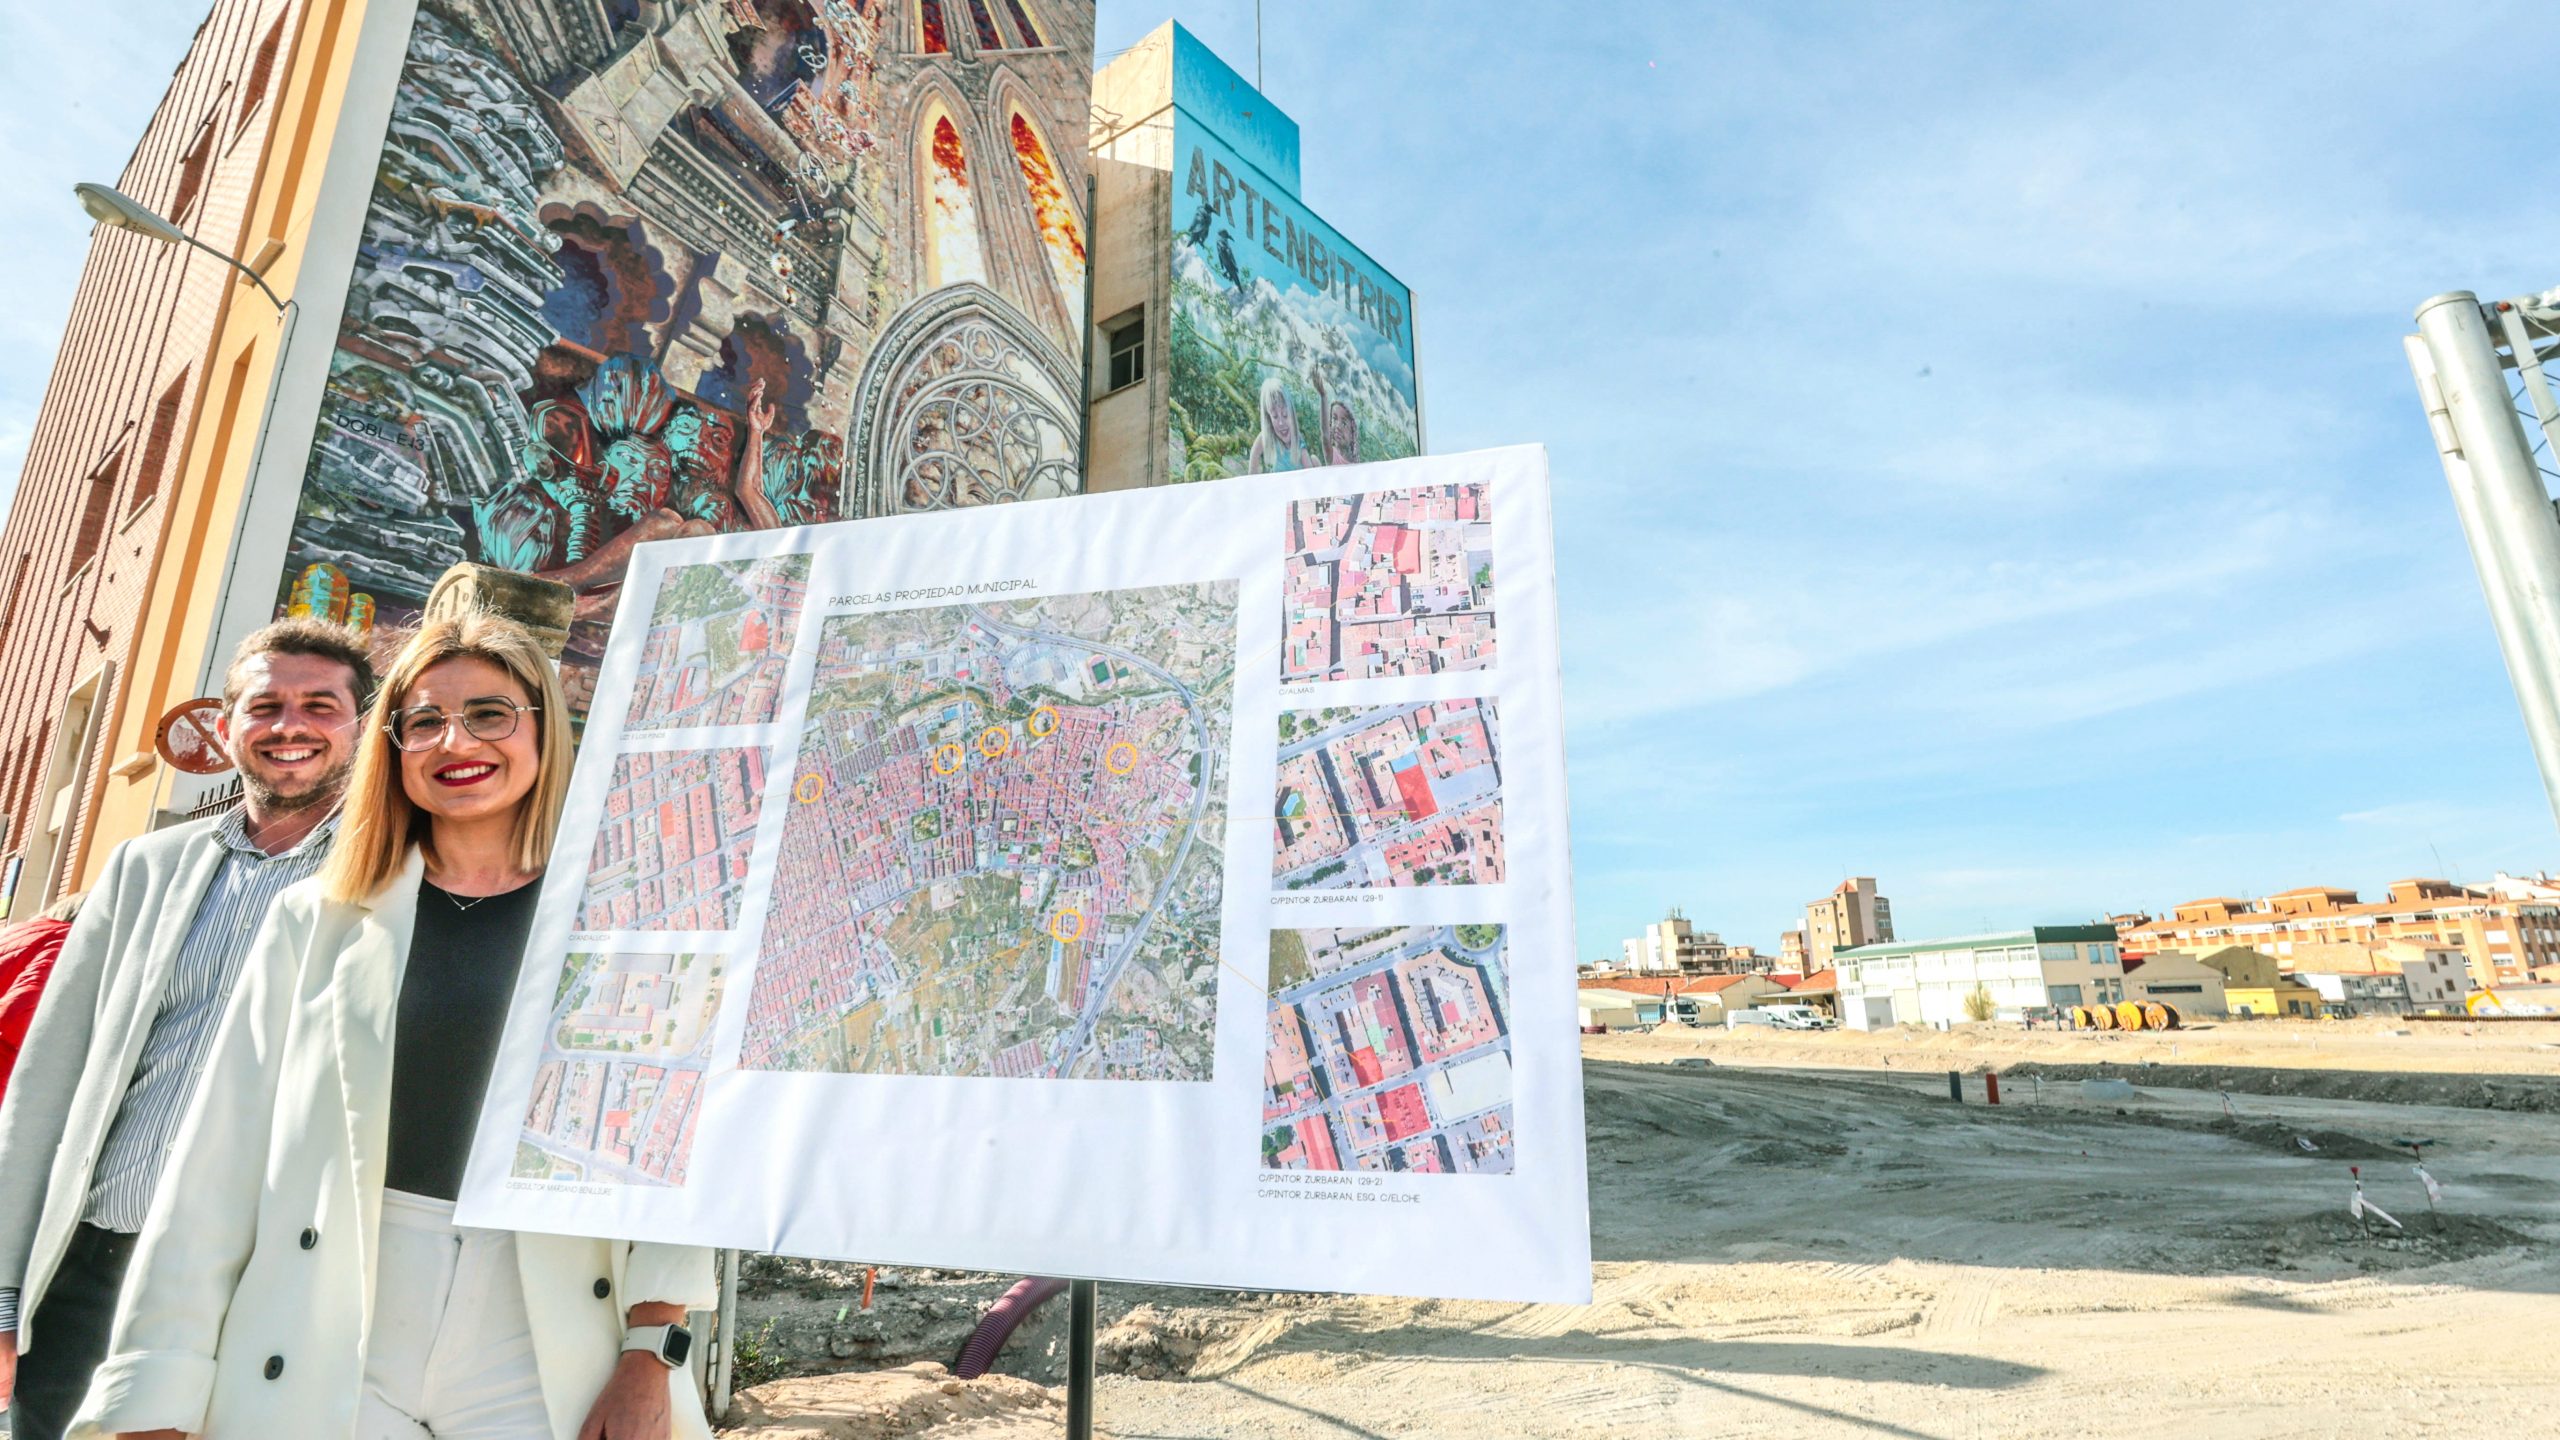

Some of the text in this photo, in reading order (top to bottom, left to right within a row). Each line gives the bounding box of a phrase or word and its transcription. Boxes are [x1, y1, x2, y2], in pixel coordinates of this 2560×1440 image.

[1186, 145, 1403, 347] ARTENBITRIR
[828, 579, 1038, 607] PARCELAS PROPIEDAD MUNICIPAL
[1278, 686, 1316, 696] C/ALMAS
[1270, 896, 1311, 905] C/PINTOR
[1312, 895, 1358, 904] ZURBARAN
[1258, 1173, 1383, 1186] C/PINTOR ZURBARAN (29-2)
[1257, 1189, 1302, 1199] C/PINTOR
[1304, 1190, 1354, 1202] ZURBARAN,
[1379, 1193, 1421, 1203] C/ELCHE
